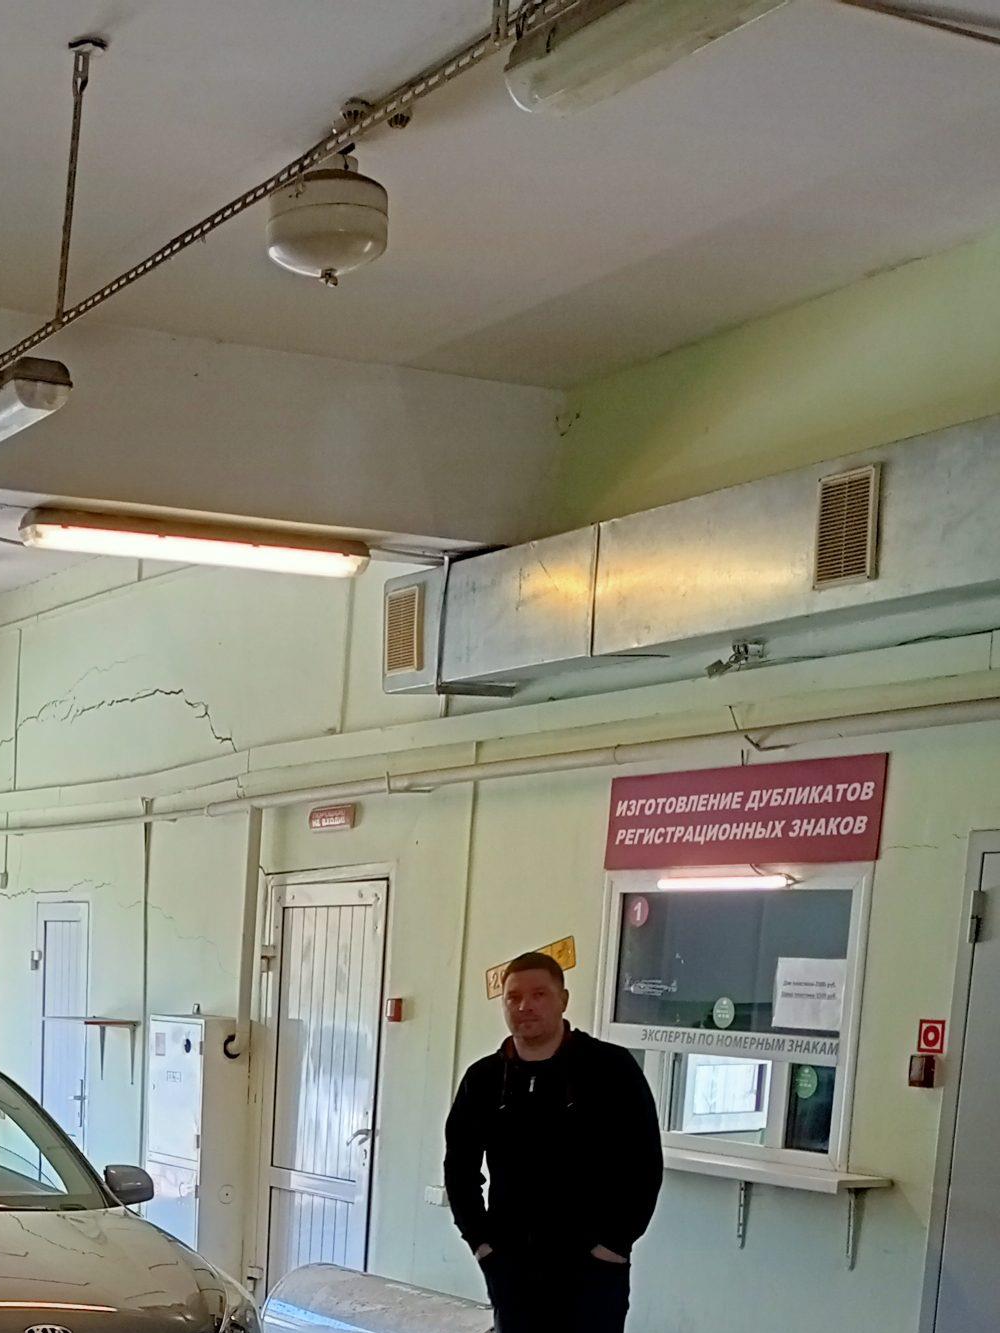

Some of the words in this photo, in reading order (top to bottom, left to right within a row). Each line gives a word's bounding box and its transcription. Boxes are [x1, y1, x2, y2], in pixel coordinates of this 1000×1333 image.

[616, 791, 744, 817] ИЗГОТОВЛЕНИЕ
[745, 781, 875, 811] ДУБЛИКАТОВ
[615, 820, 786, 845] РЕГИСТРАЦИОННЫХ
[788, 815, 868, 838] ЗНАКОВ
[633, 902, 642, 921] 1
[641, 1028, 696, 1045] ЭКСПЕРТЫ
[698, 1033, 714, 1046] ПО
[715, 1034, 785, 1051] НОМЕРНЫМ
[788, 1039, 839, 1056] ЗНАКАМ
